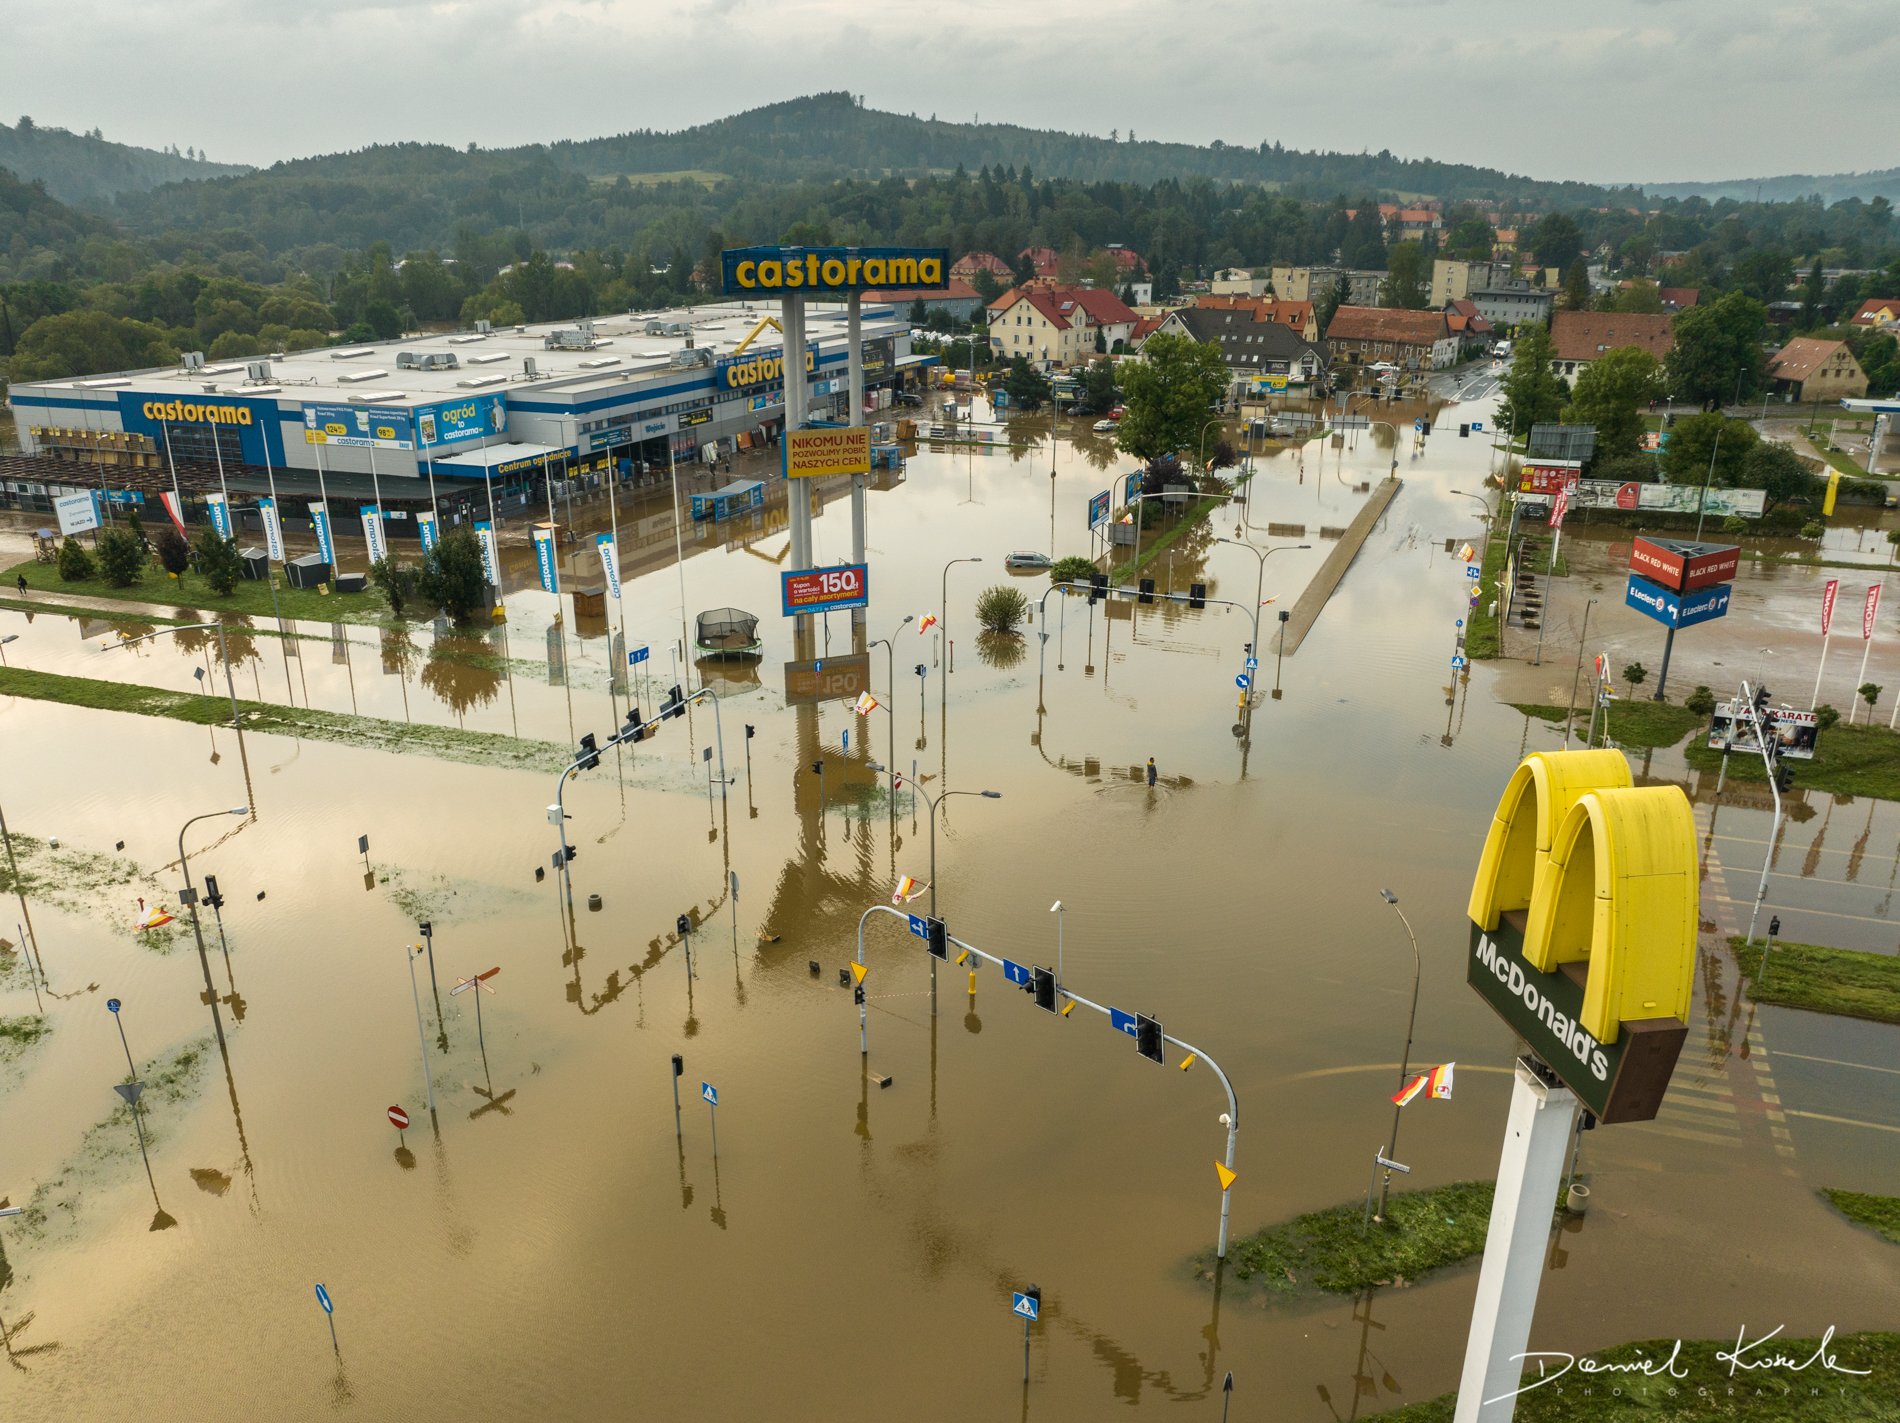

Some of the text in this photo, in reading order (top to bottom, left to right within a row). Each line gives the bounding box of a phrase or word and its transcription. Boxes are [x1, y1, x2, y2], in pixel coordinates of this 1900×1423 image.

[736, 253, 941, 288] castorama
[727, 351, 814, 389] castora
[143, 400, 252, 425] castorama
[442, 402, 476, 425] ogród
[458, 420, 465, 428] to
[444, 427, 480, 440] castorama
[337, 438, 375, 447] castorama
[792, 434, 866, 449] NIKOMU NIE
[792, 445, 866, 458] POZWOLIMY POBIĆ
[498, 449, 572, 474] Centrum ogrodnicze
[793, 458, 840, 469] NASZYCH
[842, 457, 862, 466] CEN
[59, 496, 90, 508] castorama
[1633, 550, 1680, 577] BLACK RED WHITE
[1689, 560, 1736, 578] BLACK RED WHITE
[793, 582, 811, 590] Kupon
[818, 570, 856, 594] 150
[798, 586, 820, 594] wartości
[803, 594, 818, 603] cały
[830, 602, 862, 611] castorama
[1772, 710, 1818, 722] KARATE
[1476, 934, 1608, 1082] McDonald's
